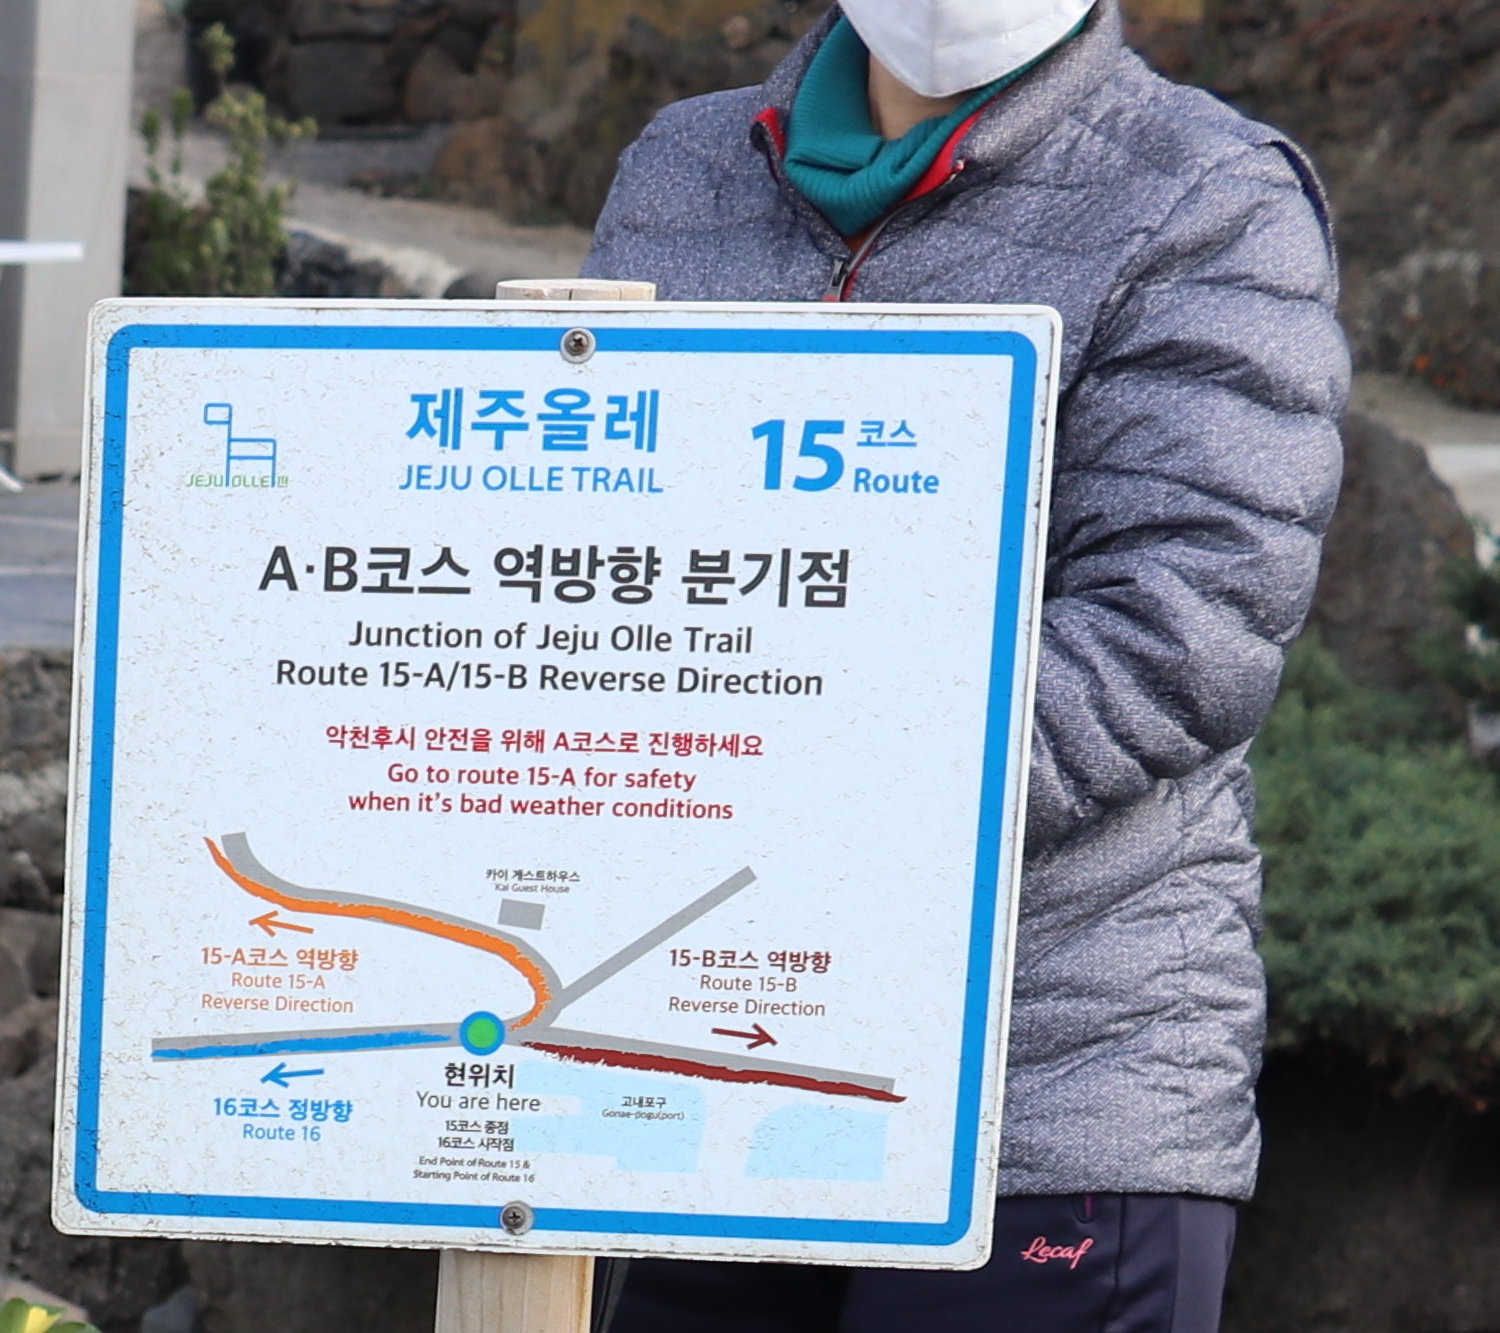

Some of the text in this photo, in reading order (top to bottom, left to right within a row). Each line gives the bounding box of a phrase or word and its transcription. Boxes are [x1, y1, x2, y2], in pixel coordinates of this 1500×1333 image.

[406, 387, 659, 453] 제주올레
[856, 420, 917, 448] 코스
[752, 419, 845, 492] 15
[399, 464, 664, 494] JEJU OLLE TRAIL
[853, 467, 939, 494] Route
[493, 544, 662, 605] 역방향
[681, 548, 849, 608] 분기점
[348, 620, 752, 656] Junction of Jeju Olle Trail
[277, 659, 822, 696] Route 15-A/15-B Reverse Direction
[326, 725, 763, 758] 악천후시 안전을 위해 A코스로 진행하세요
[388, 763, 696, 793] Go to route 15-A for safety
[349, 791, 410, 811] when
[460, 793, 502, 814] bad
[510, 795, 605, 816] weather
[612, 798, 733, 820] conditions
[202, 947, 359, 972] 15-A코스 역방향
[670, 949, 831, 974] 15-B코스 역방향
[231, 972, 325, 990] Route 15-A
[700, 974, 797, 993] Route 15-B
[201, 993, 353, 1013] Reverse Direction
[669, 996, 825, 1017] Reverse Direction
[444, 1062, 514, 1089] 현위치
[214, 1097, 353, 1123] 16코스 정방향
[417, 1091, 541, 1112] You are here
[243, 1123, 321, 1142] Route 16
[446, 1120, 481, 1133] 15코스
[438, 1136, 515, 1152] 16코스 시작점
[418, 1155, 531, 1169] End Point of Route 15 &
[413, 1169, 535, 1183] Starting Point of Route 16
[1021, 1236, 1094, 1270] Lecaf
